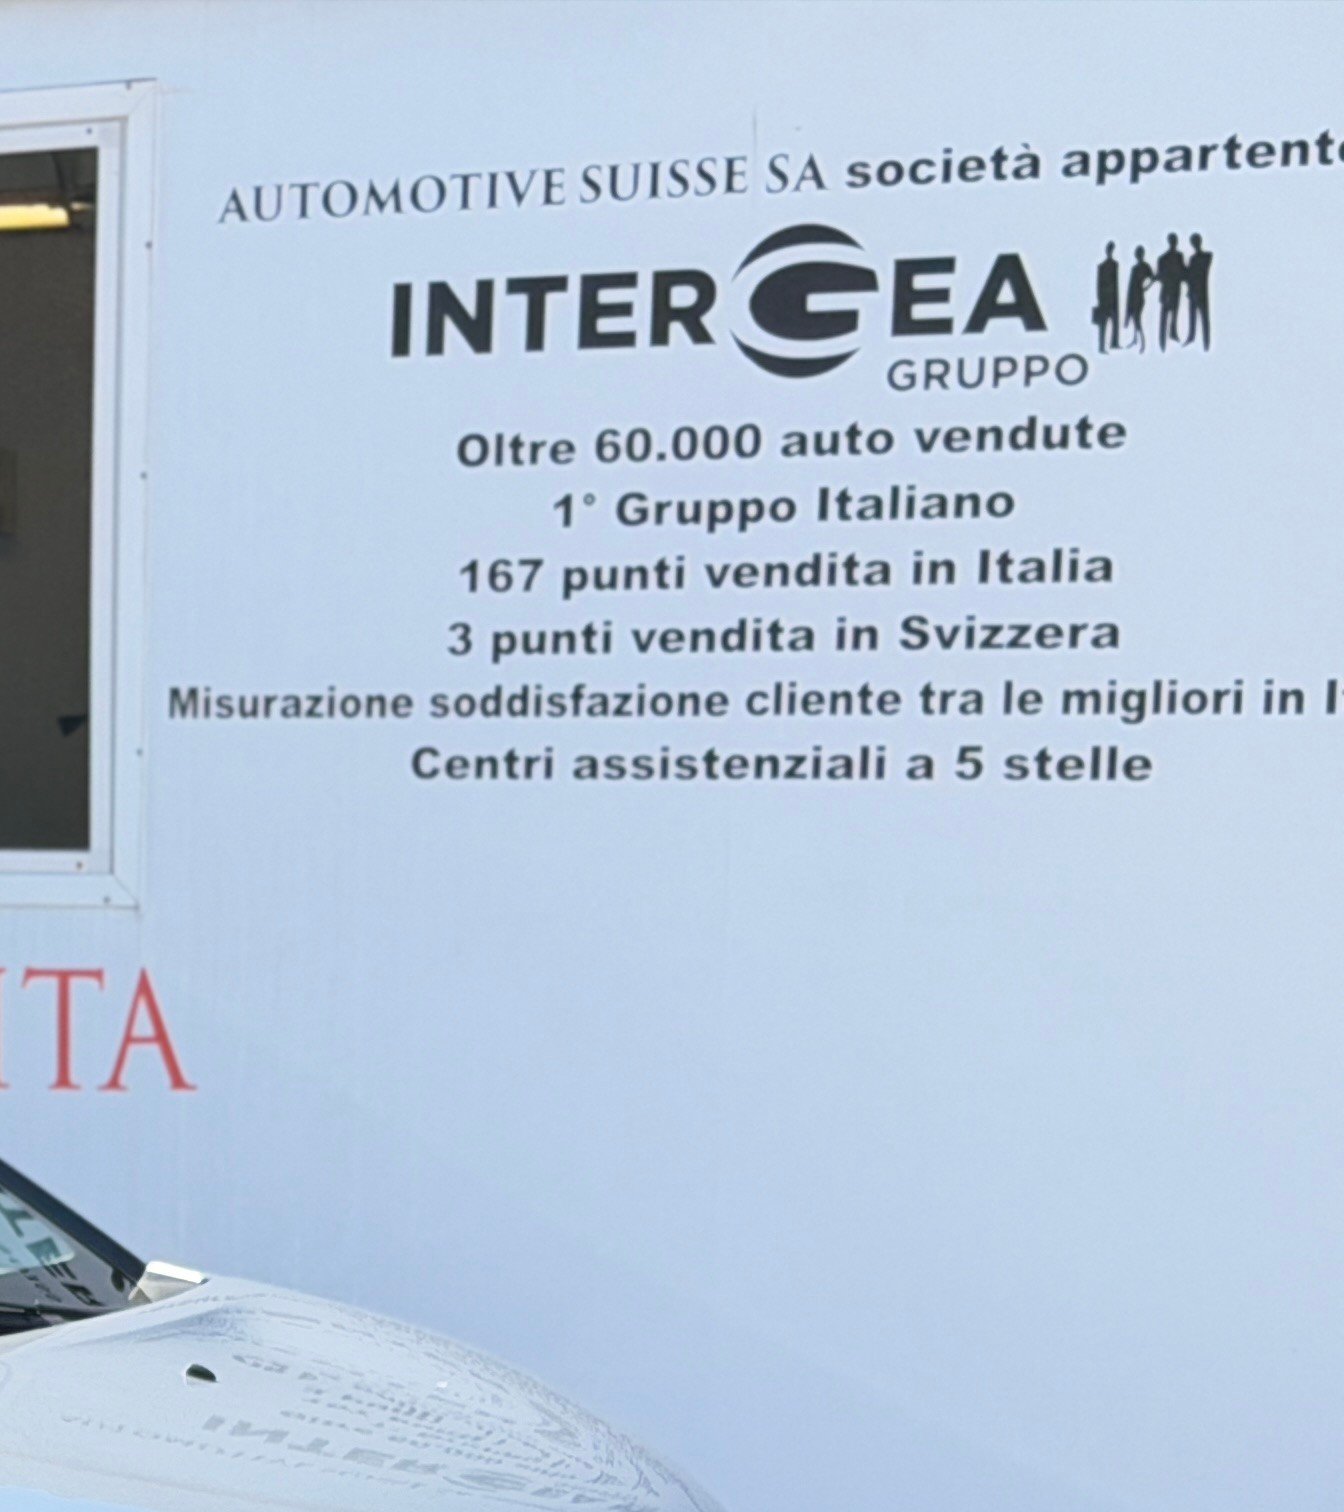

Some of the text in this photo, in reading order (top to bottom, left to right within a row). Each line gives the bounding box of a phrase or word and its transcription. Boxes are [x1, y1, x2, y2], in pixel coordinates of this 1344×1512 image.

[218, 129, 1344, 223] AUTOMOTIVE SUISSE SA società appartent
[886, 352, 1089, 392] GRUPPO
[456, 415, 1127, 468] Oltre 60.000 auto vendute
[553, 484, 1015, 534] 1° Gruppo Italiano
[460, 547, 1113, 601] 167 punti vendita in Italia
[447, 614, 1120, 665] 3 punti vendita in Svizzera
[168, 678, 1344, 725] Misurazione soddisfazione cliente tra le migliori in I
[411, 745, 1153, 782] Centri assistenziali a 5 stelle
